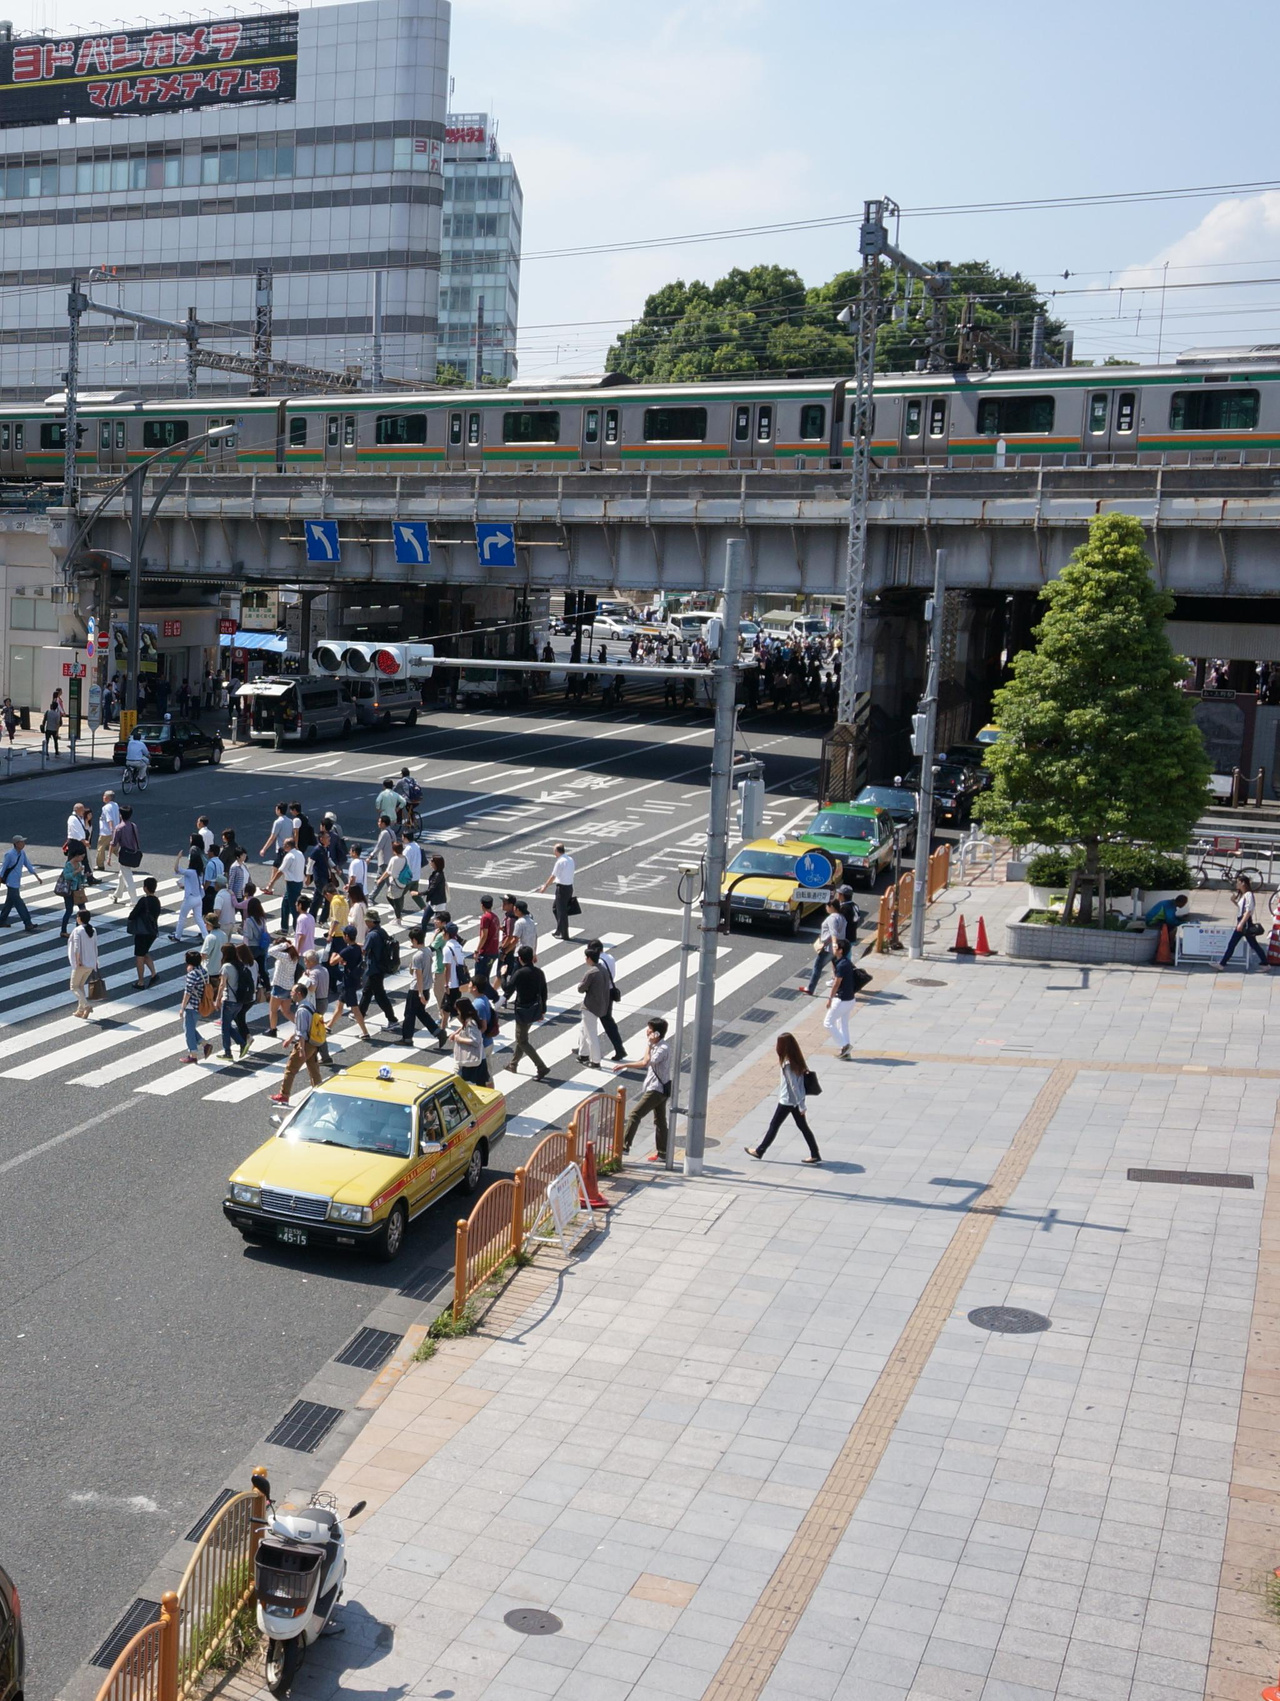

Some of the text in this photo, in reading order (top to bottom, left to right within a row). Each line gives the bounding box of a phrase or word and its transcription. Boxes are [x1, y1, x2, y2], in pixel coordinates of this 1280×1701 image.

[12, 22, 243, 82] ヨドバシカメラ
[87, 67, 280, 108] マルチメディア上野
[795, 890, 827, 901] 自転車通行可
